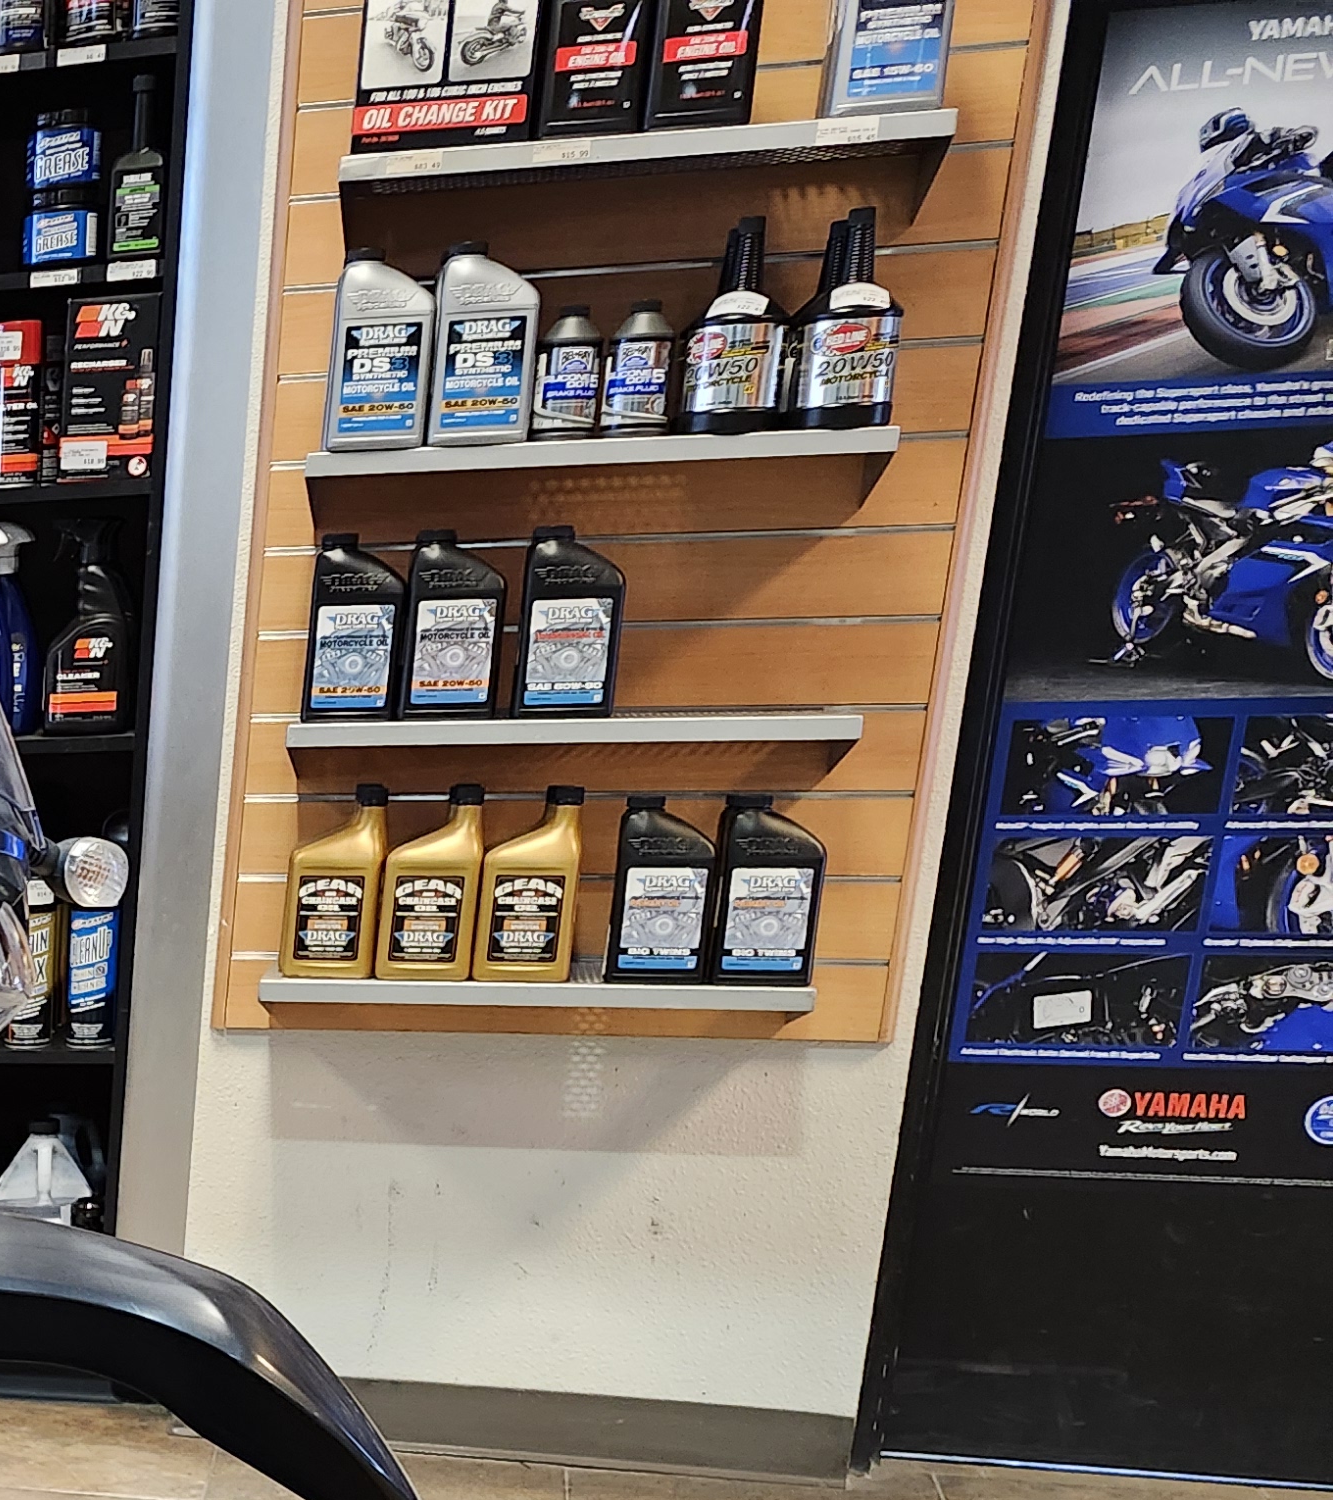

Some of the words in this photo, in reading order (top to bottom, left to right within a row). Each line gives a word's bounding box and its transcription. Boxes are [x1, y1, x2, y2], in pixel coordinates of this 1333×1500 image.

[855, 30, 923, 45] MOTORCYCLE
[924, 27, 941, 39] OIL
[676, 44, 716, 59] ENGINE
[718, 41, 737, 55] OIL
[567, 54, 606, 67] ENGINE
[608, 52, 626, 65] OIL
[363, 108, 392, 130] OIL
[398, 102, 478, 128] CHANGE
[481, 99, 517, 121] KIT
[35, 148, 89, 180] GREASE
[35, 230, 77, 252] GREASE
[99, 303, 136, 337] K&N
[465, 319, 511, 334] DRAG
[361, 326, 407, 340] DRAG
[826, 332, 847, 346] RED
[848, 329, 869, 344] LINE
[74, 341, 120, 350] PERFORMANCE
[347, 345, 418, 360] PREMIUM
[449, 340, 522, 355] PREMIUM
[70, 360, 127, 369] RECHARGER
[352, 357, 409, 373] DS3
[455, 351, 513, 368] DS3
[818, 352, 895, 377] 20W50
[13, 365, 34, 387] K&N
[352, 370, 408, 381] SYNTHETIC
[454, 364, 512, 375] SYNTHETIC
[343, 383, 400, 395] MOTORCYCLE
[401, 382, 416, 392] OIL
[445, 377, 503, 389] MOTORCYCLE
[505, 376, 520, 386] OIL
[607, 386, 633, 396] BRAKE
[635, 383, 660, 393] FLUID
[545, 390, 571, 398] BRAKE
[572, 389, 596, 397] FLUID
[1074, 390, 1134, 402] Redefining
[1135, 390, 1155, 398] the
[342, 404, 365, 413] SAE
[444, 399, 467, 408] SAE
[336, 613, 380, 627] DRAG
[436, 606, 480, 620] DRAG
[548, 607, 593, 620] DRAG
[419, 632, 475, 641] MOTORCYCLE
[478, 631, 491, 640] OIL
[89, 637, 113, 658] K&N
[320, 639, 374, 648] MOTORCYCLE
[376, 639, 389, 647] OIL
[56, 672, 100, 680] CLEANER
[419, 680, 439, 688] SAE
[298, 878, 363, 899] GEAR
[395, 878, 463, 899] GEAR
[495, 878, 564, 899] GEAR
[644, 876, 690, 888] DRAG
[750, 876, 796, 888] DRAG
[307, 931, 347, 942] DRAG
[404, 931, 444, 942] DRAG
[503, 931, 545, 942] DRAG
[1134, 1091, 1246, 1119] YAMAHA
[1098, 1143, 1237, 1161] YamahaMotorsports.com
